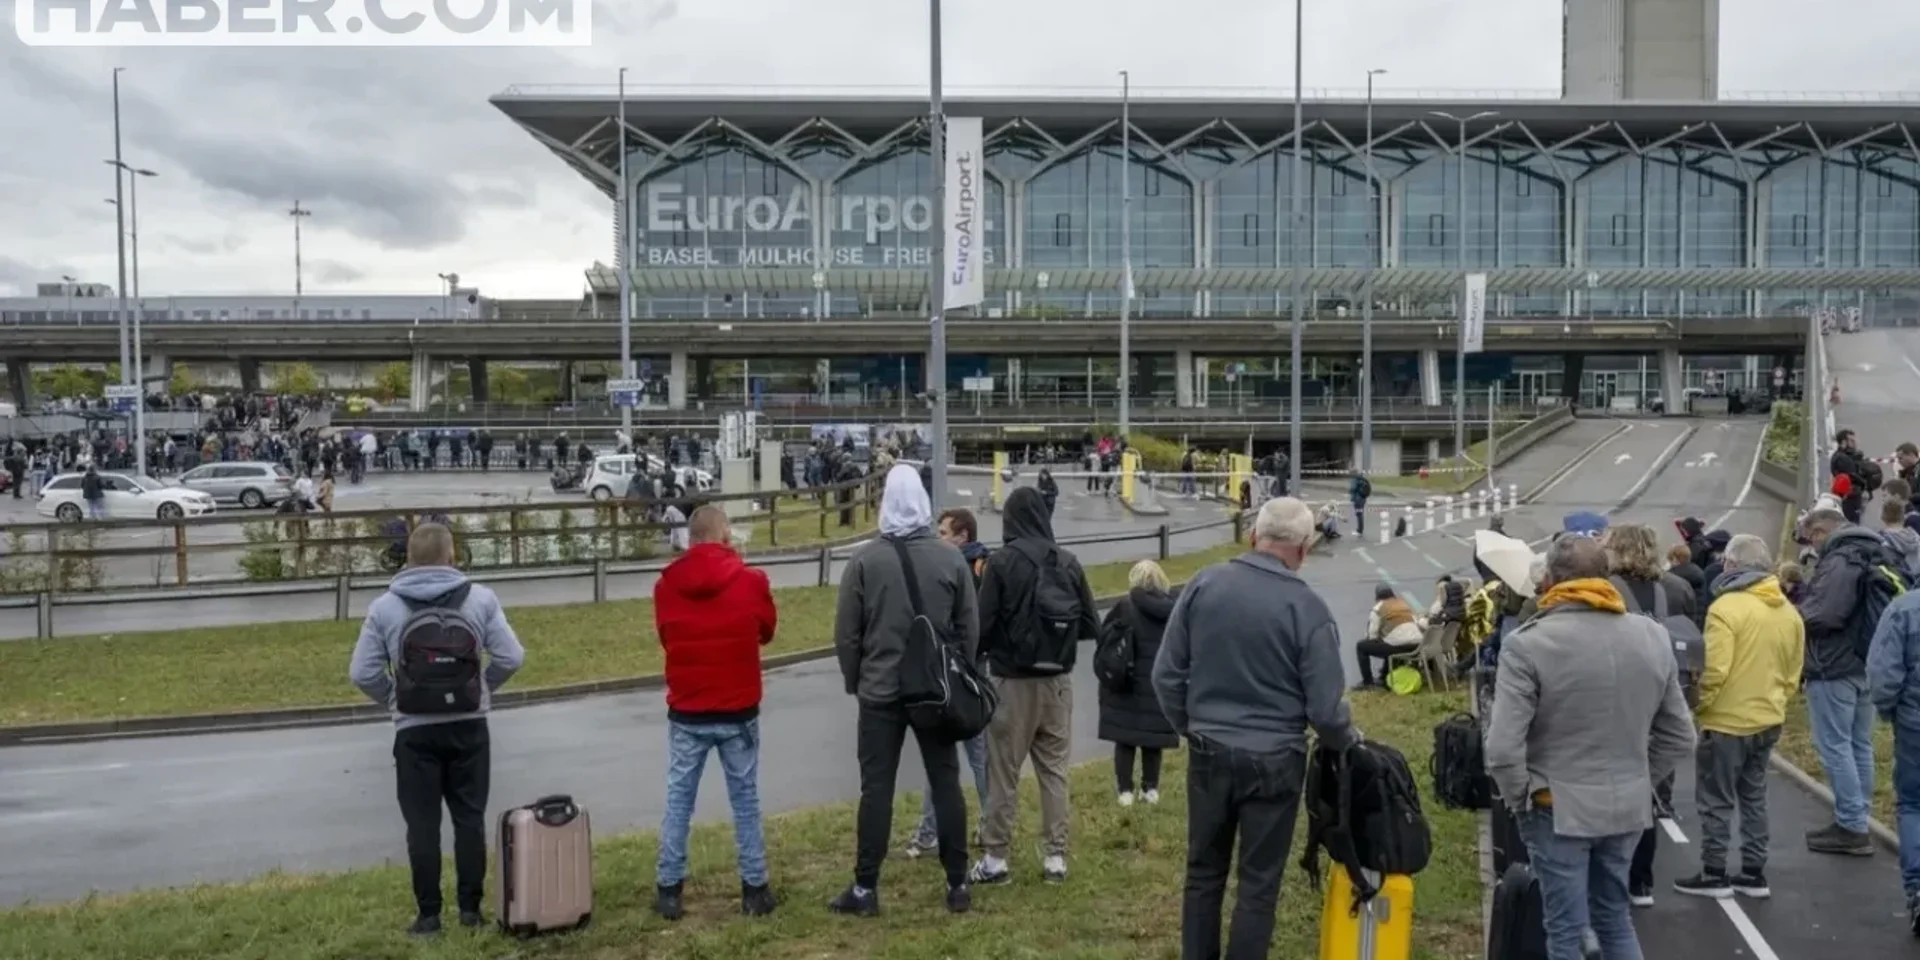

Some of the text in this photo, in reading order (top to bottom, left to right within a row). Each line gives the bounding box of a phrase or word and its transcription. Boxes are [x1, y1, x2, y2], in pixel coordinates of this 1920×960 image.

[649, 247, 994, 265] BASEL MULHOSE FREIG
